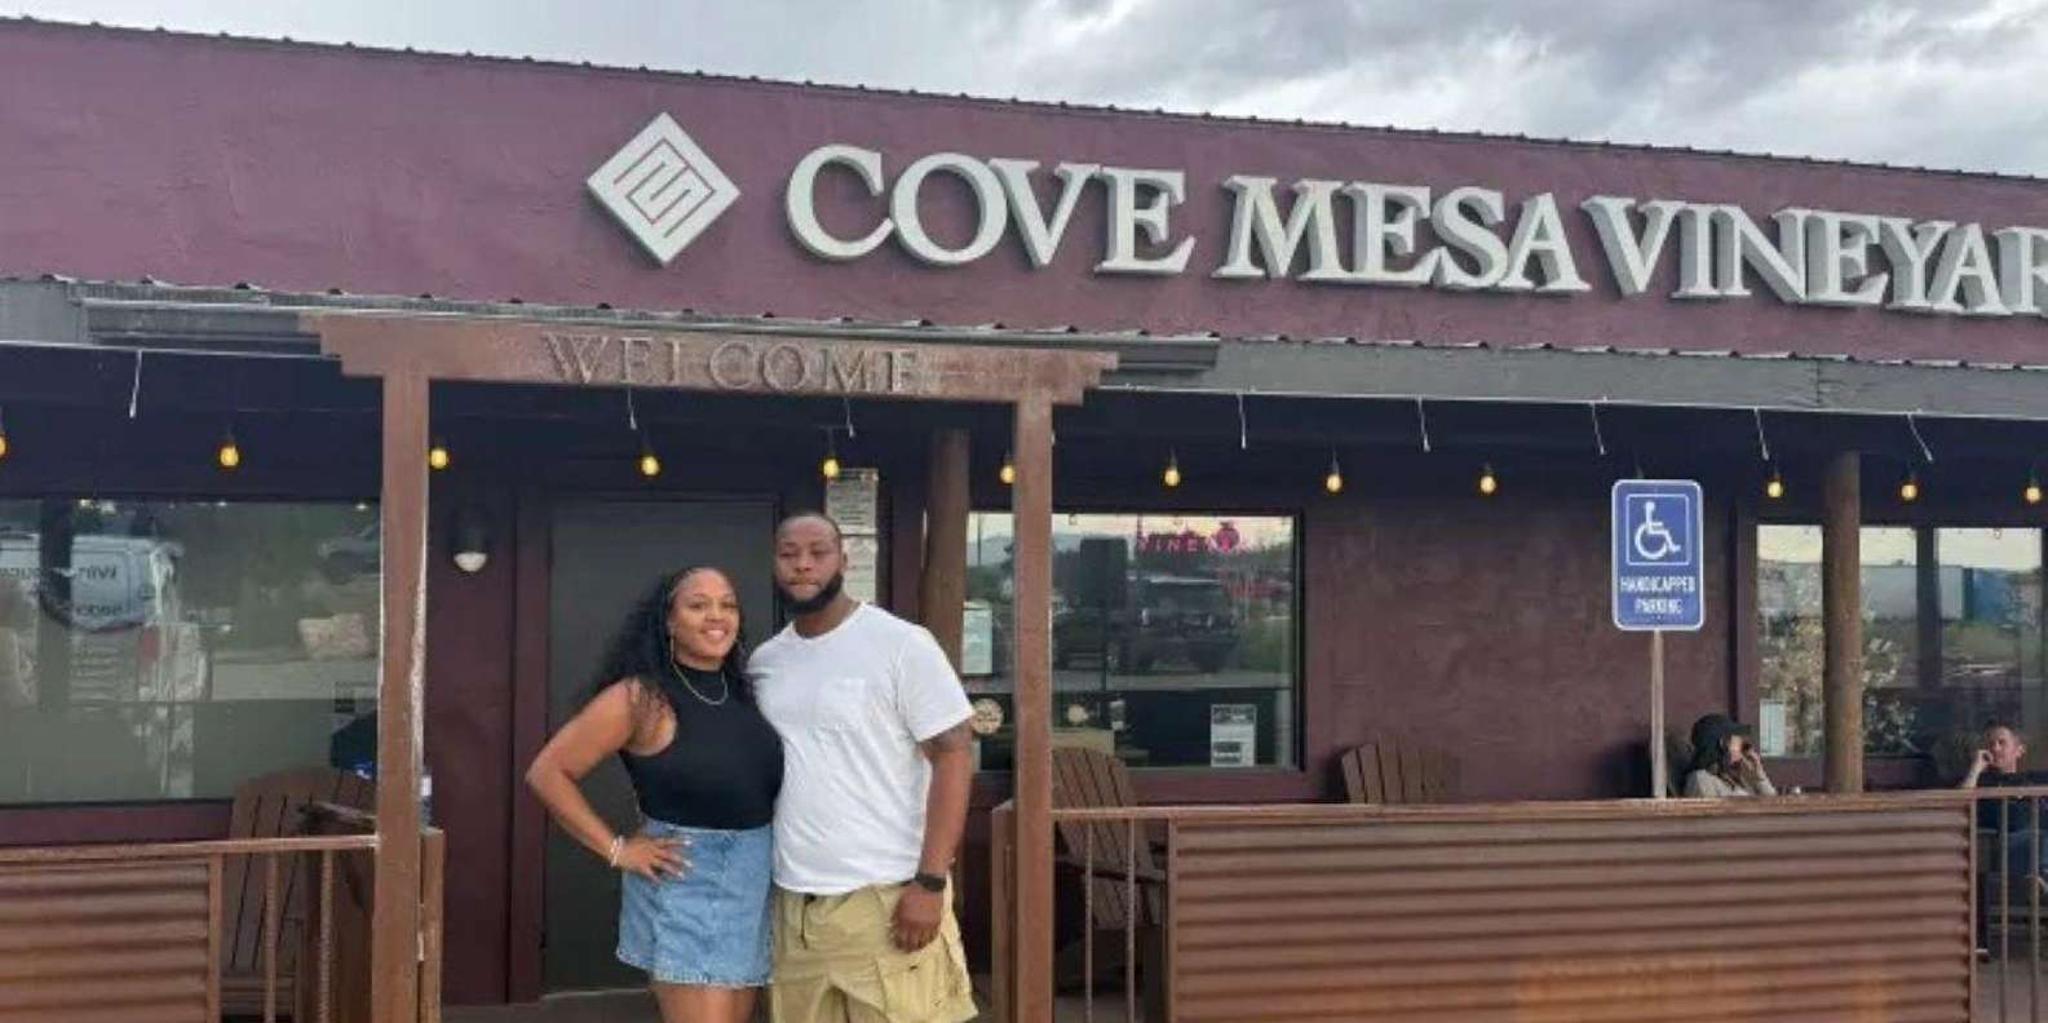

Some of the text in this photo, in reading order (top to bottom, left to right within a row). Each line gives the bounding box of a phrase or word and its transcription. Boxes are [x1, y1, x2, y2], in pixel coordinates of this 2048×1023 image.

[786, 144, 1196, 275] COVE
[1212, 173, 1592, 294] MESA
[542, 331, 921, 394] WELCOME
[1619, 575, 1696, 593] HANDICAPPED
[1634, 598, 1684, 614] PARKING
